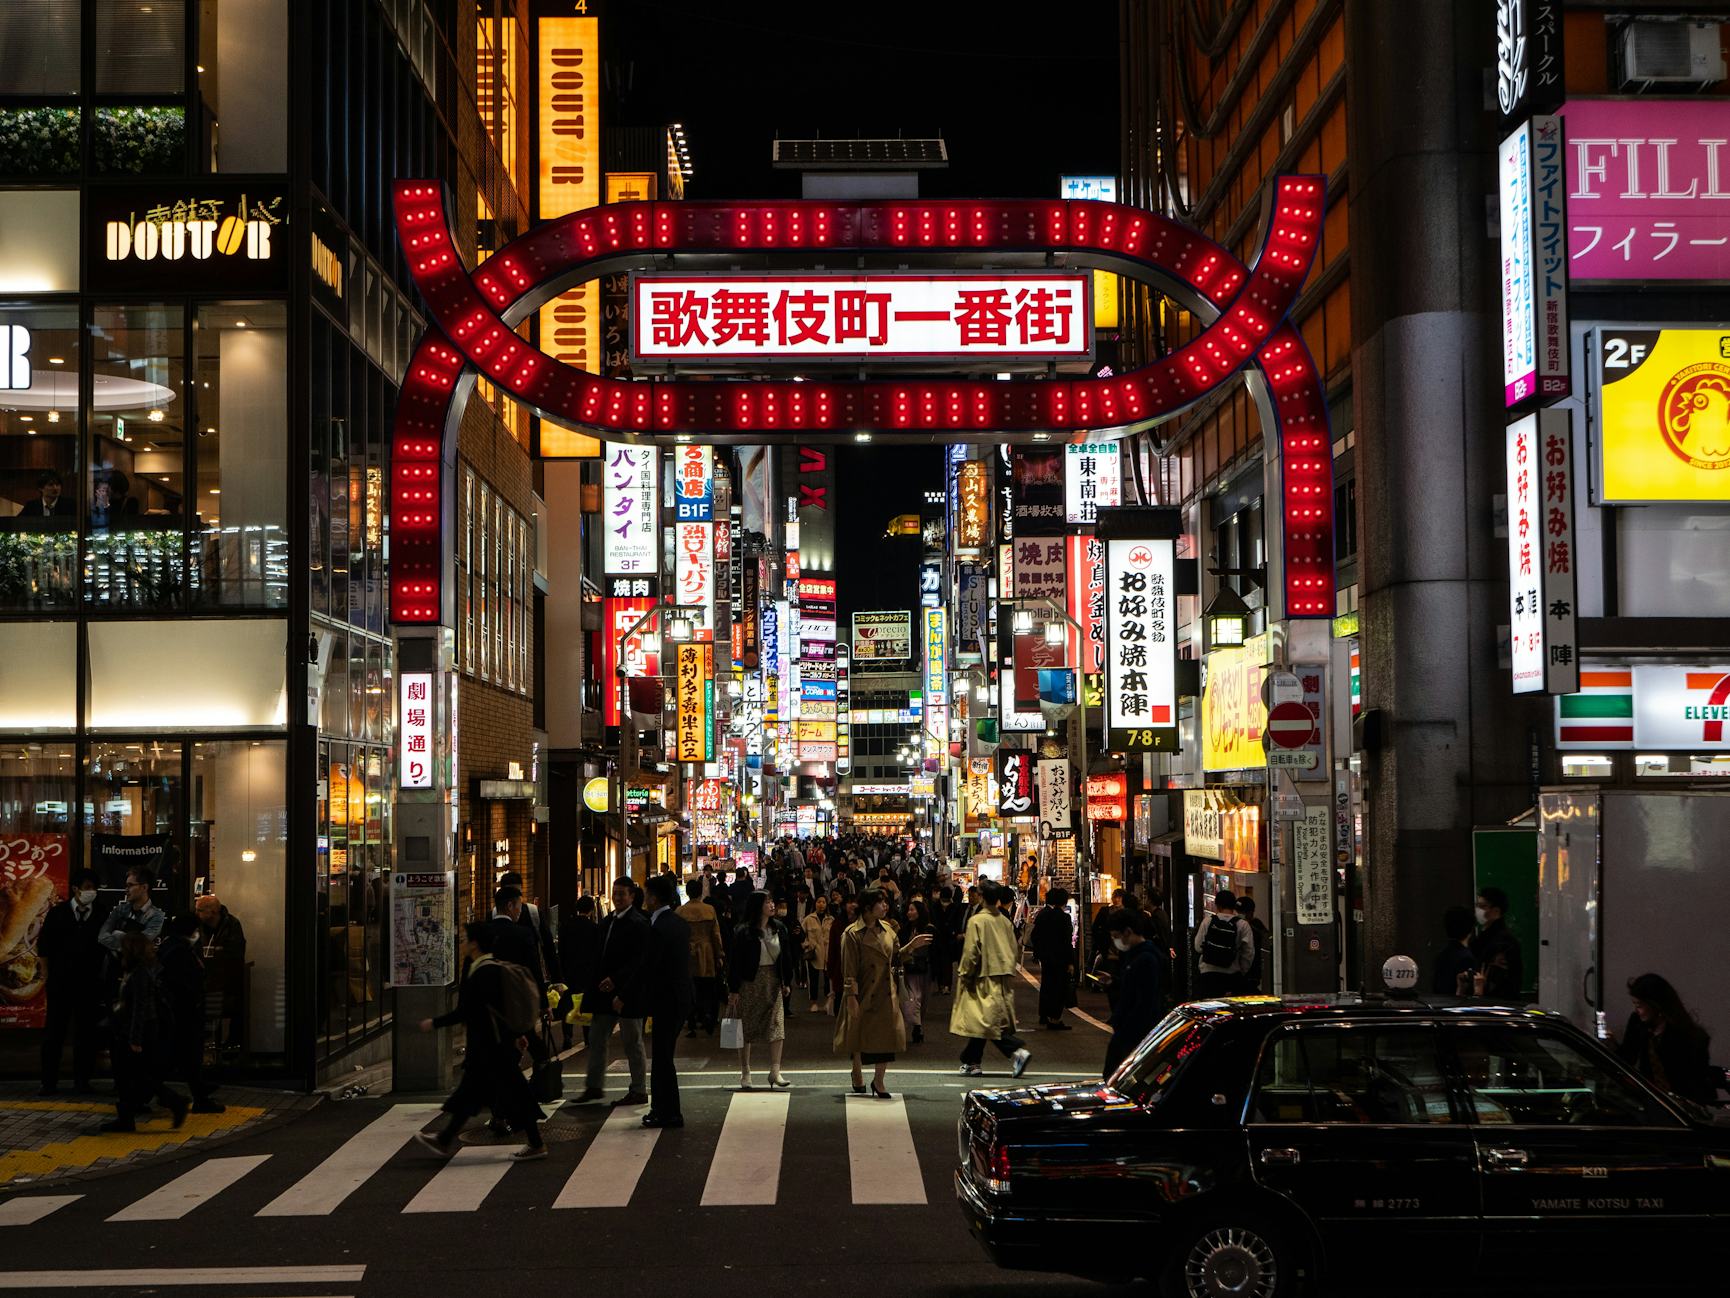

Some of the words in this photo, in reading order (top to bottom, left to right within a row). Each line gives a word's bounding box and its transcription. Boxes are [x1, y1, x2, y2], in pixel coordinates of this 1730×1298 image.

[551, 48, 588, 185] DOUTOR
[106, 216, 271, 260] DOUTOR
[1536, 143, 1563, 297] ファイトフィット
[1573, 222, 1728, 260] フィラー
[651, 289, 1073, 347] 歌舞伎町一番街
[1546, 300, 1560, 371] 新宿歌舞伎町
[1604, 339, 1646, 368] 2F
[1543, 379, 1566, 392] B2F
[1068, 443, 1118, 454] 全卓全自動
[610, 449, 636, 539] バンタイ
[641, 450, 652, 532] タイ国料理専門店
[1080, 457, 1097, 521] 東南荘
[679, 504, 709, 517] B1F
[1016, 505, 1063, 518] 酒場牧場
[621, 560, 640, 570] 3F
[614, 579, 649, 597] 焼肉
[763, 610, 777, 659] カラオケ
[1118, 571, 1149, 717] お好み焼本陣
[407, 682, 426, 779] 劇場通り
[1270, 754, 1315, 766] 自転車を除く
[102, 844, 163, 856] information
[1388, 1198, 1420, 1209] 2773
[1532, 1199, 1581, 1209] YAMATE
[1588, 1199, 1629, 1209] KOTSU
[1636, 1199, 1664, 1209] TAXI
